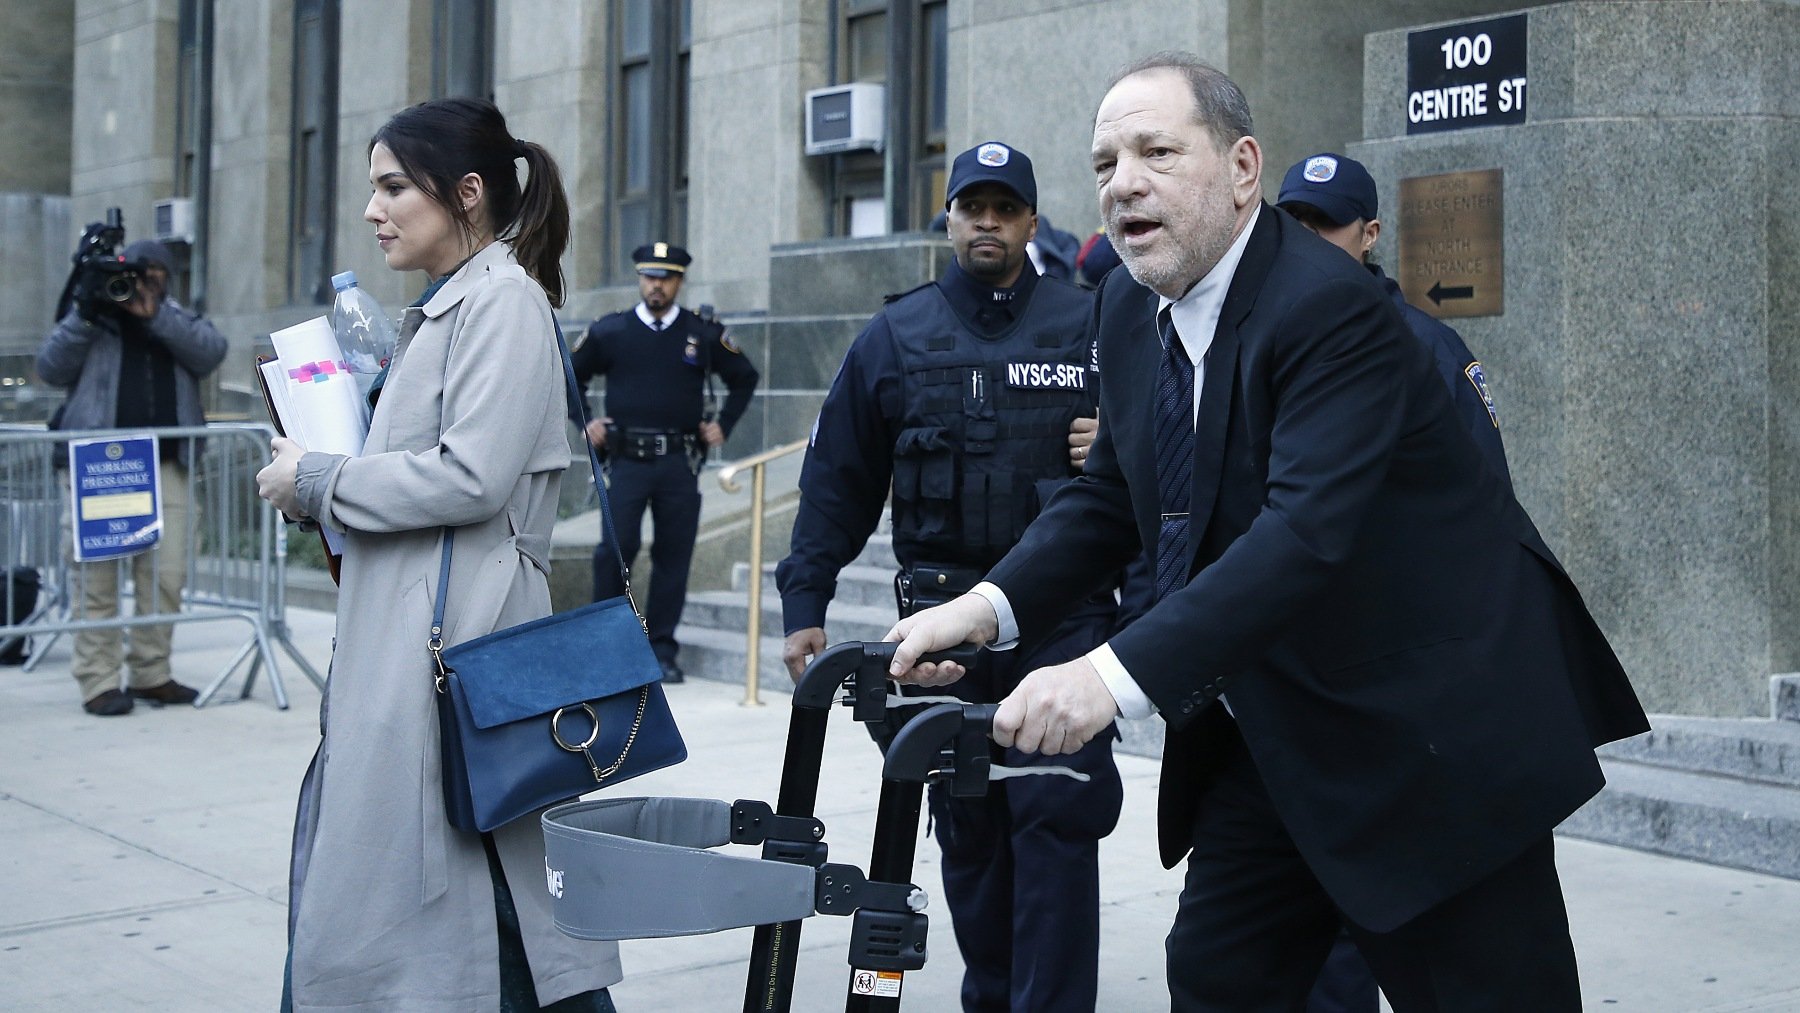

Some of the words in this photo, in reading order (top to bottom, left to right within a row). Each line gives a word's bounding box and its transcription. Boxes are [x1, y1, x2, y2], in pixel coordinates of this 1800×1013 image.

[1440, 33, 1492, 70] 100
[1408, 82, 1488, 124] CENTRE
[1497, 77, 1527, 113] ST
[1454, 194, 1495, 212] ENTER
[1427, 239, 1471, 255] NORTH
[1416, 257, 1483, 277] ENTRANCE
[1008, 363, 1085, 388] NYSC-SRT
[85, 461, 145, 475] WORKING
[82, 476, 116, 490] PRESS
[117, 473, 150, 487] ONLY
[108, 519, 129, 533] NO
[82, 532, 155, 549] EXCEPTNS
